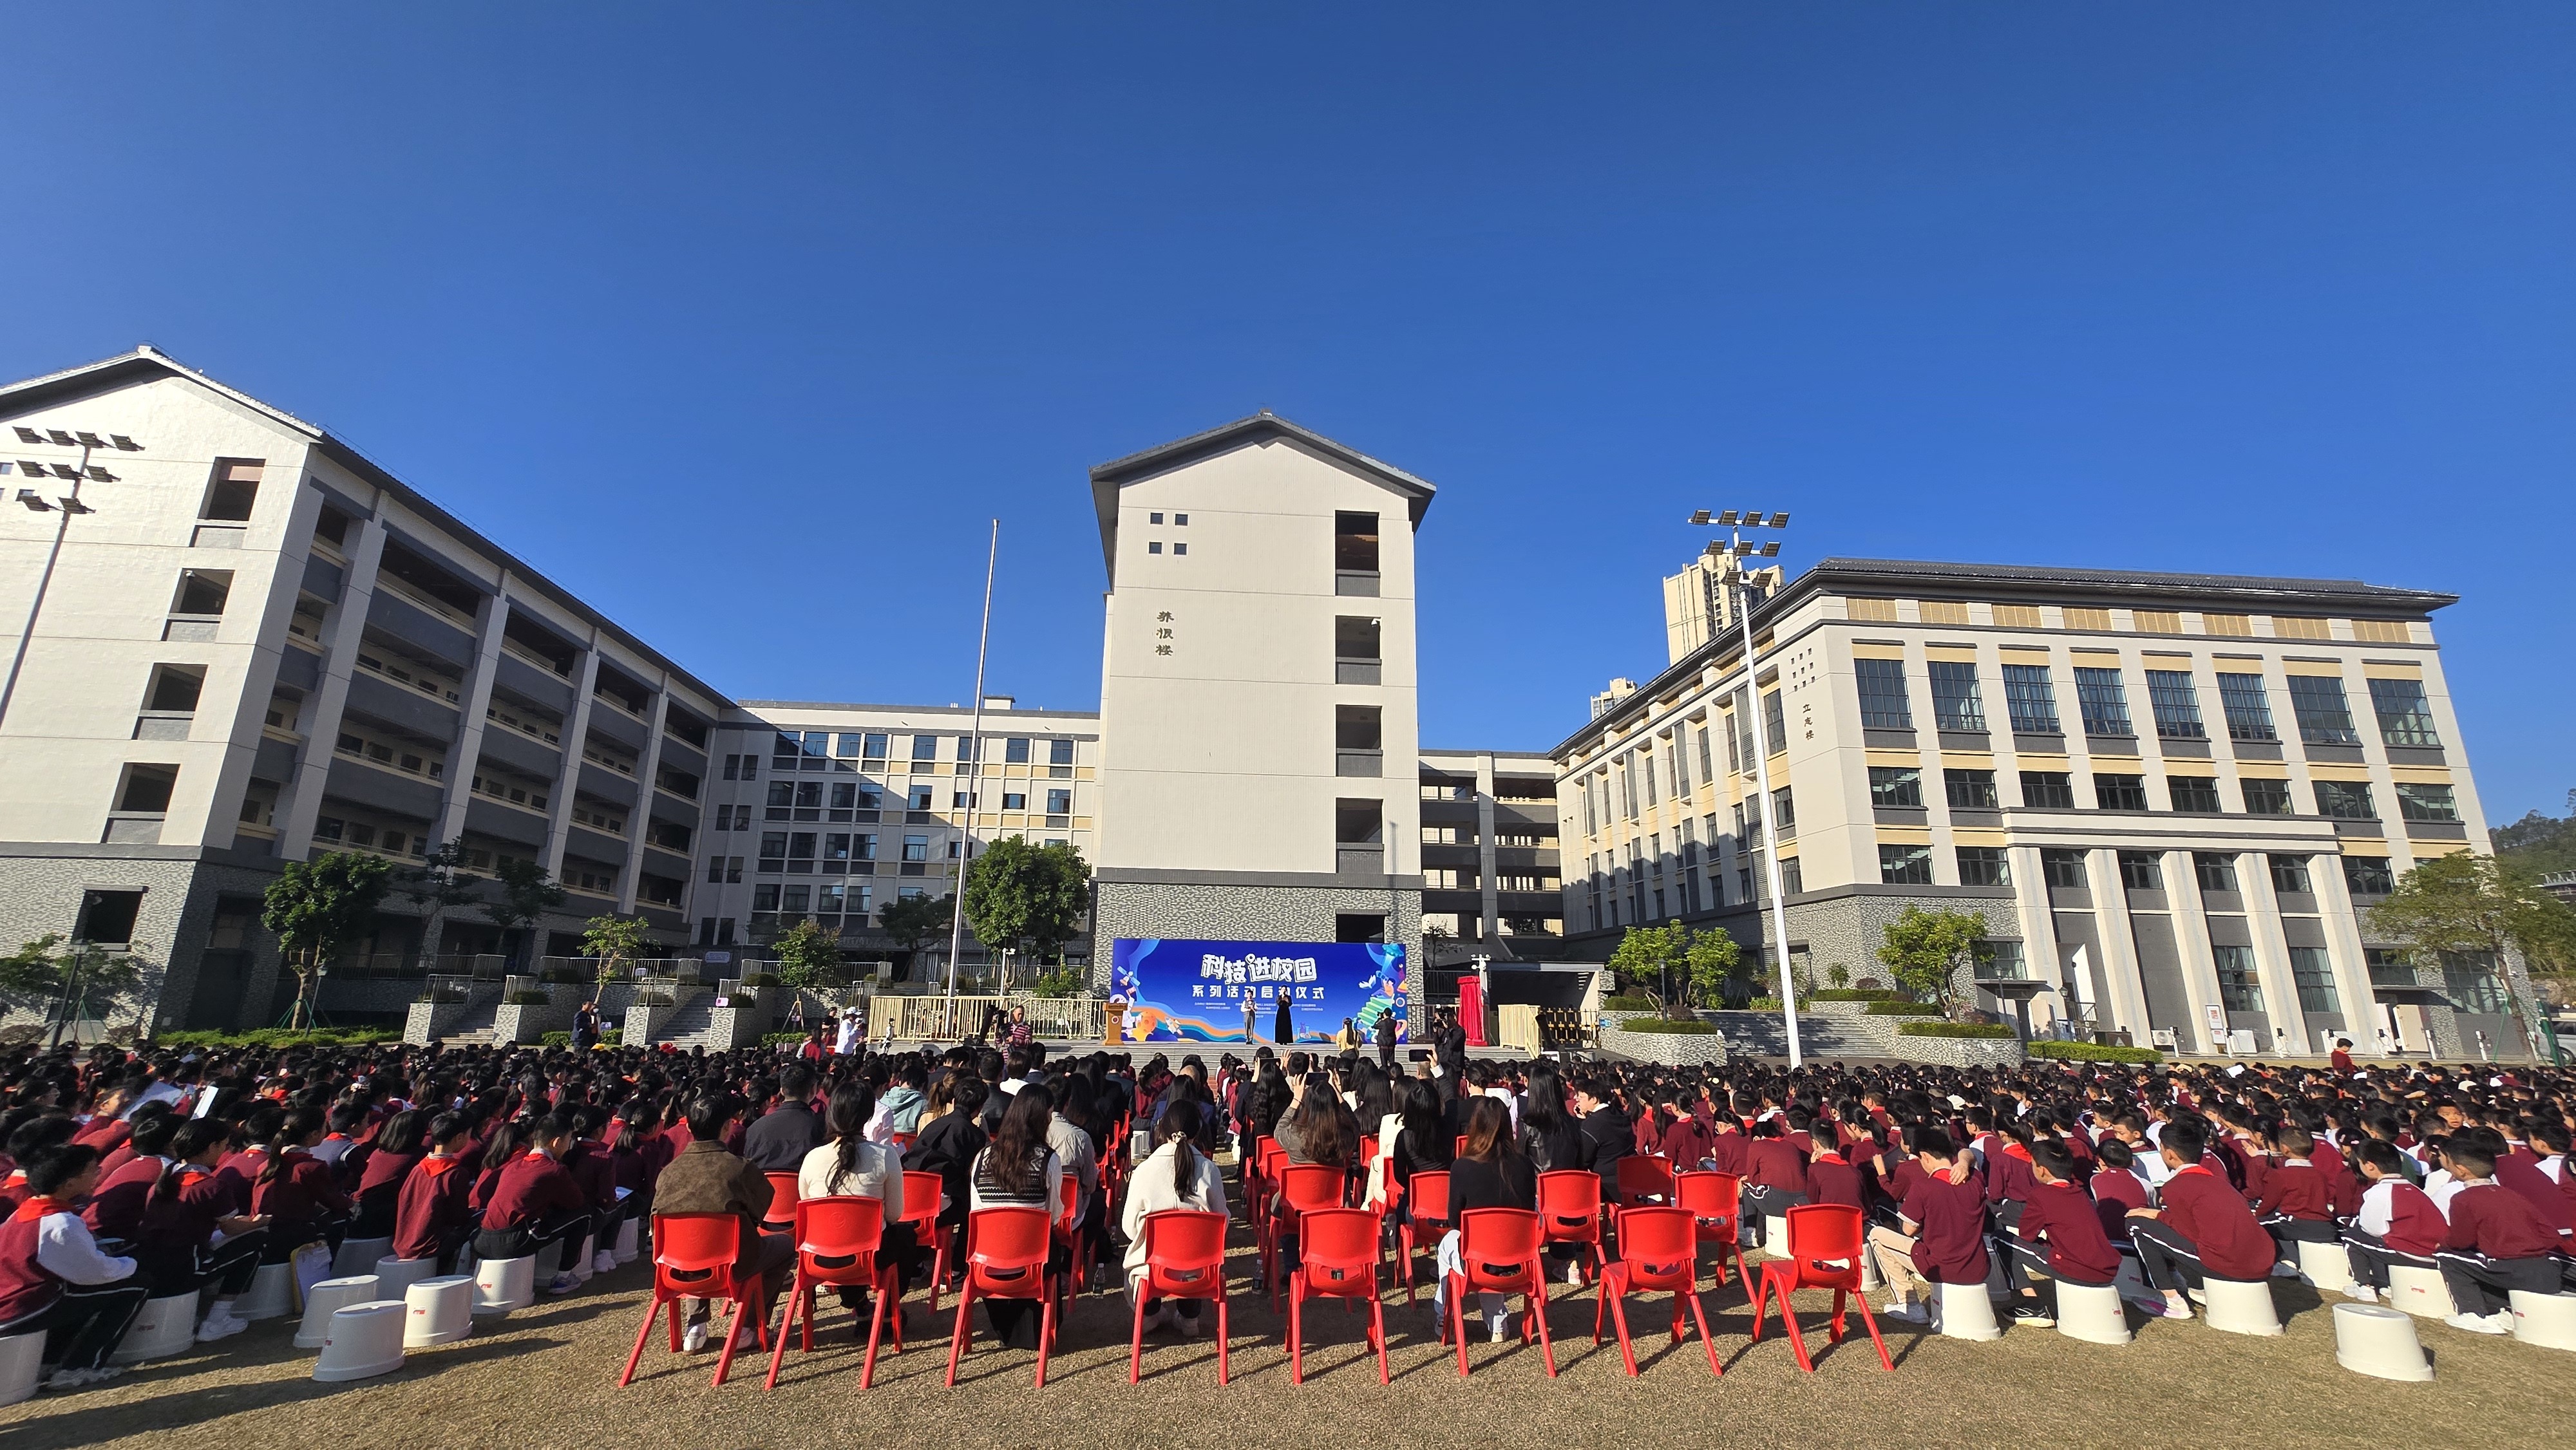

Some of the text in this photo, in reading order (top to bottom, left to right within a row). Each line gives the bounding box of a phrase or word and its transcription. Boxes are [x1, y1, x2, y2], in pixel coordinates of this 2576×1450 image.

[1803, 704, 1814, 740] 立志楼
[1201, 954, 1317, 984] 科技进校园
